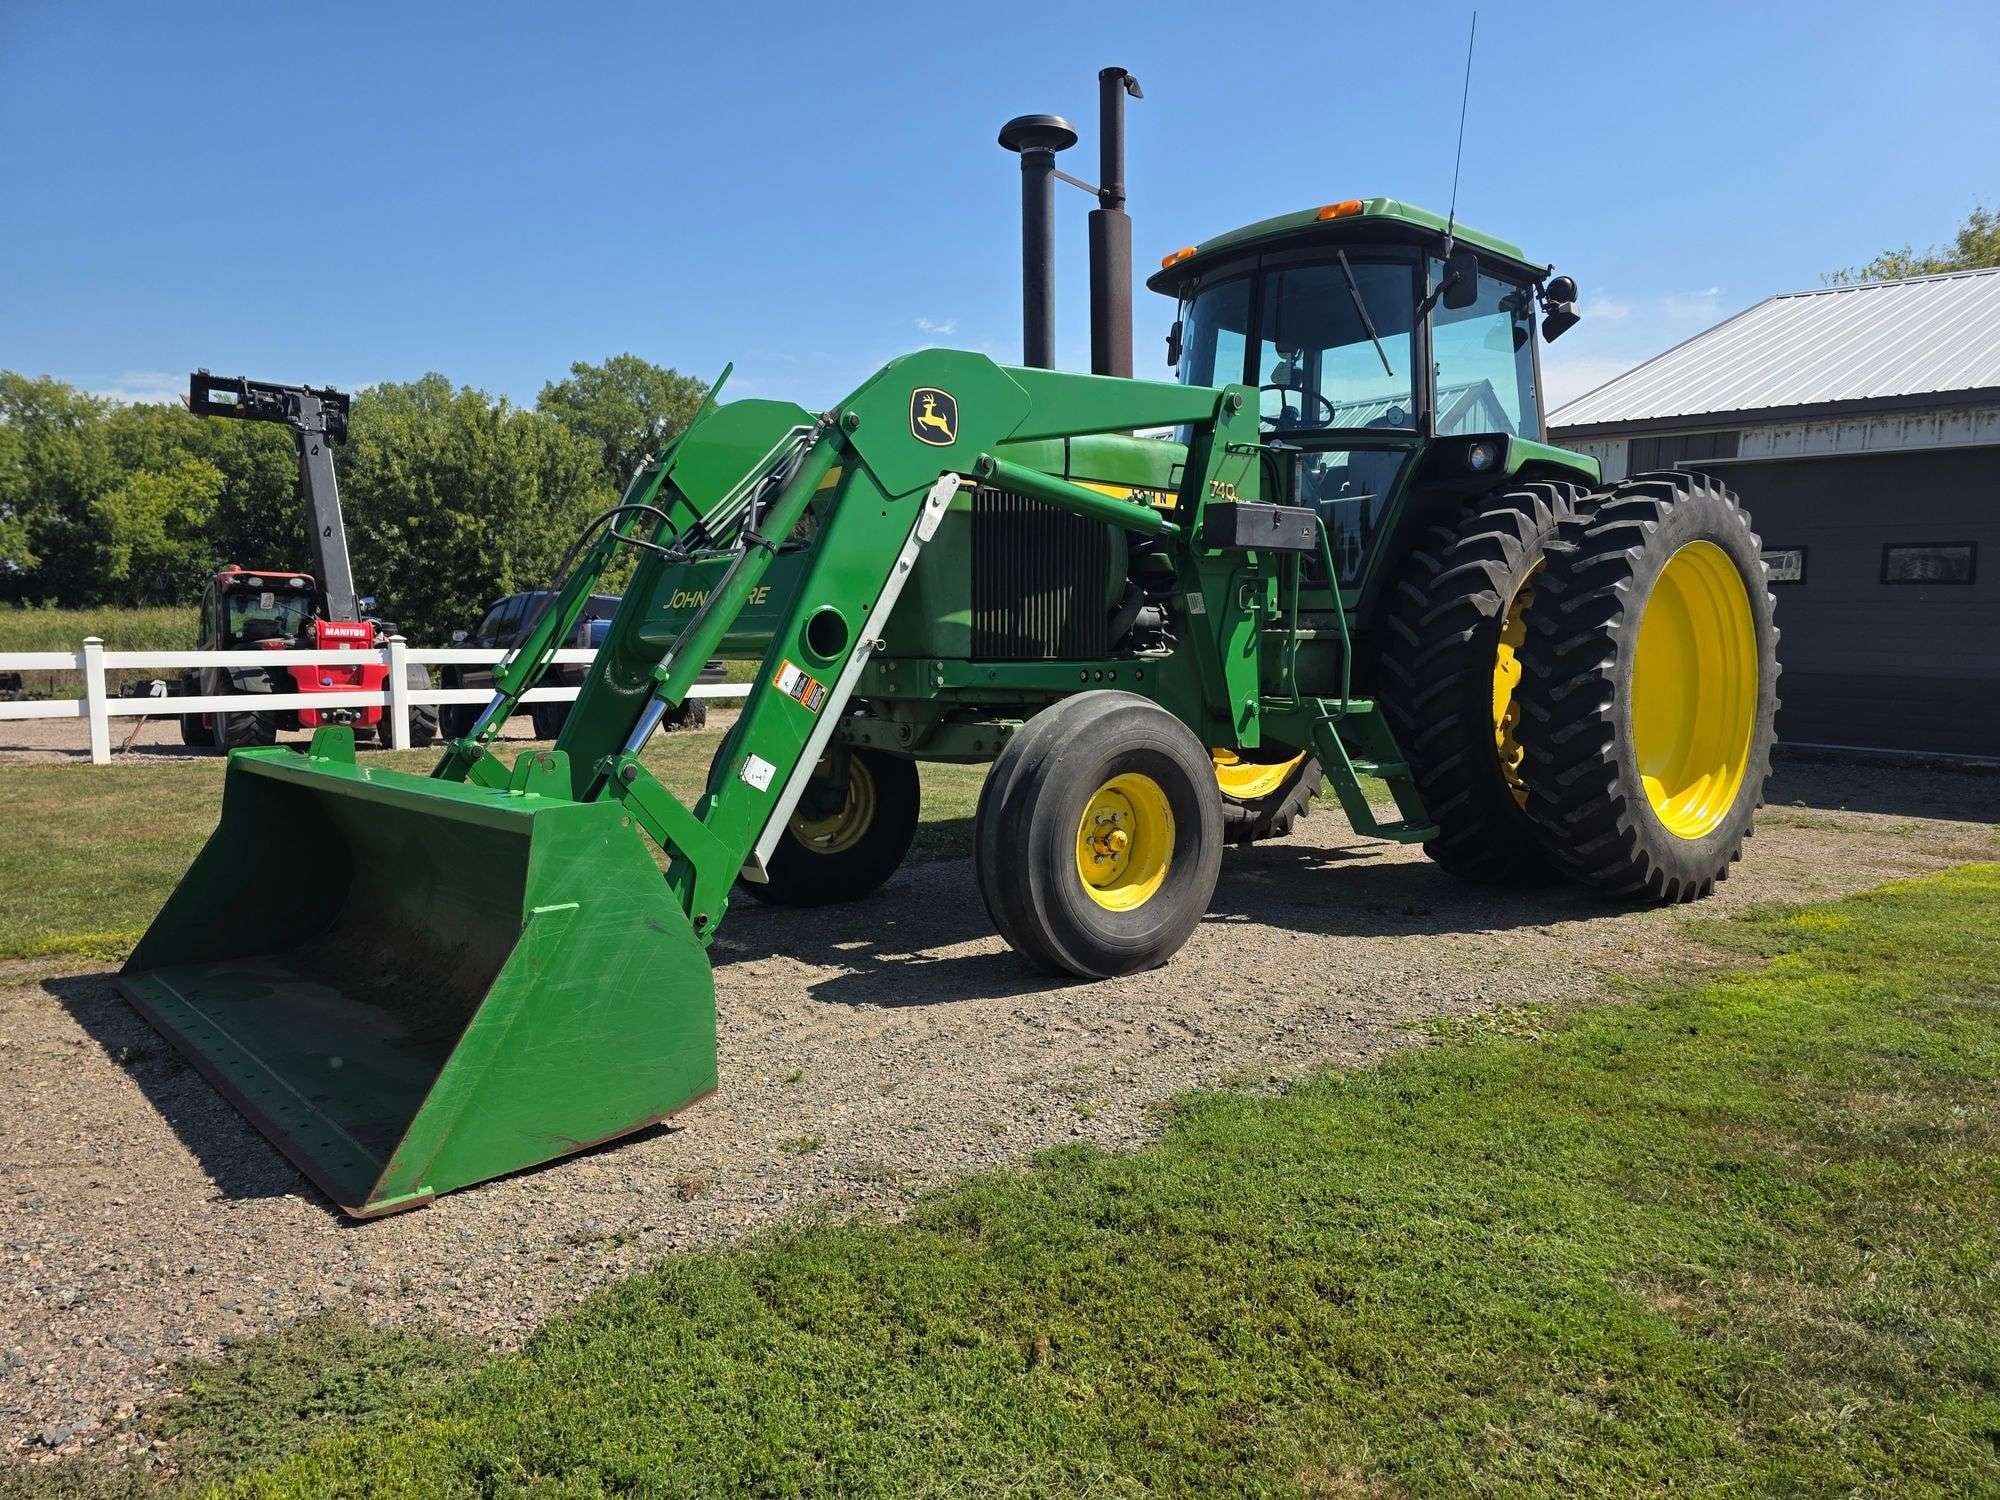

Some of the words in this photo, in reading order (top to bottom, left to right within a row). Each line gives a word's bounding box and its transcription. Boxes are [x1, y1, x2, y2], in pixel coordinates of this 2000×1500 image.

[1209, 480, 1236, 501] 740
[663, 588, 710, 609] JOHN
[324, 627, 366, 637] MANITOU
